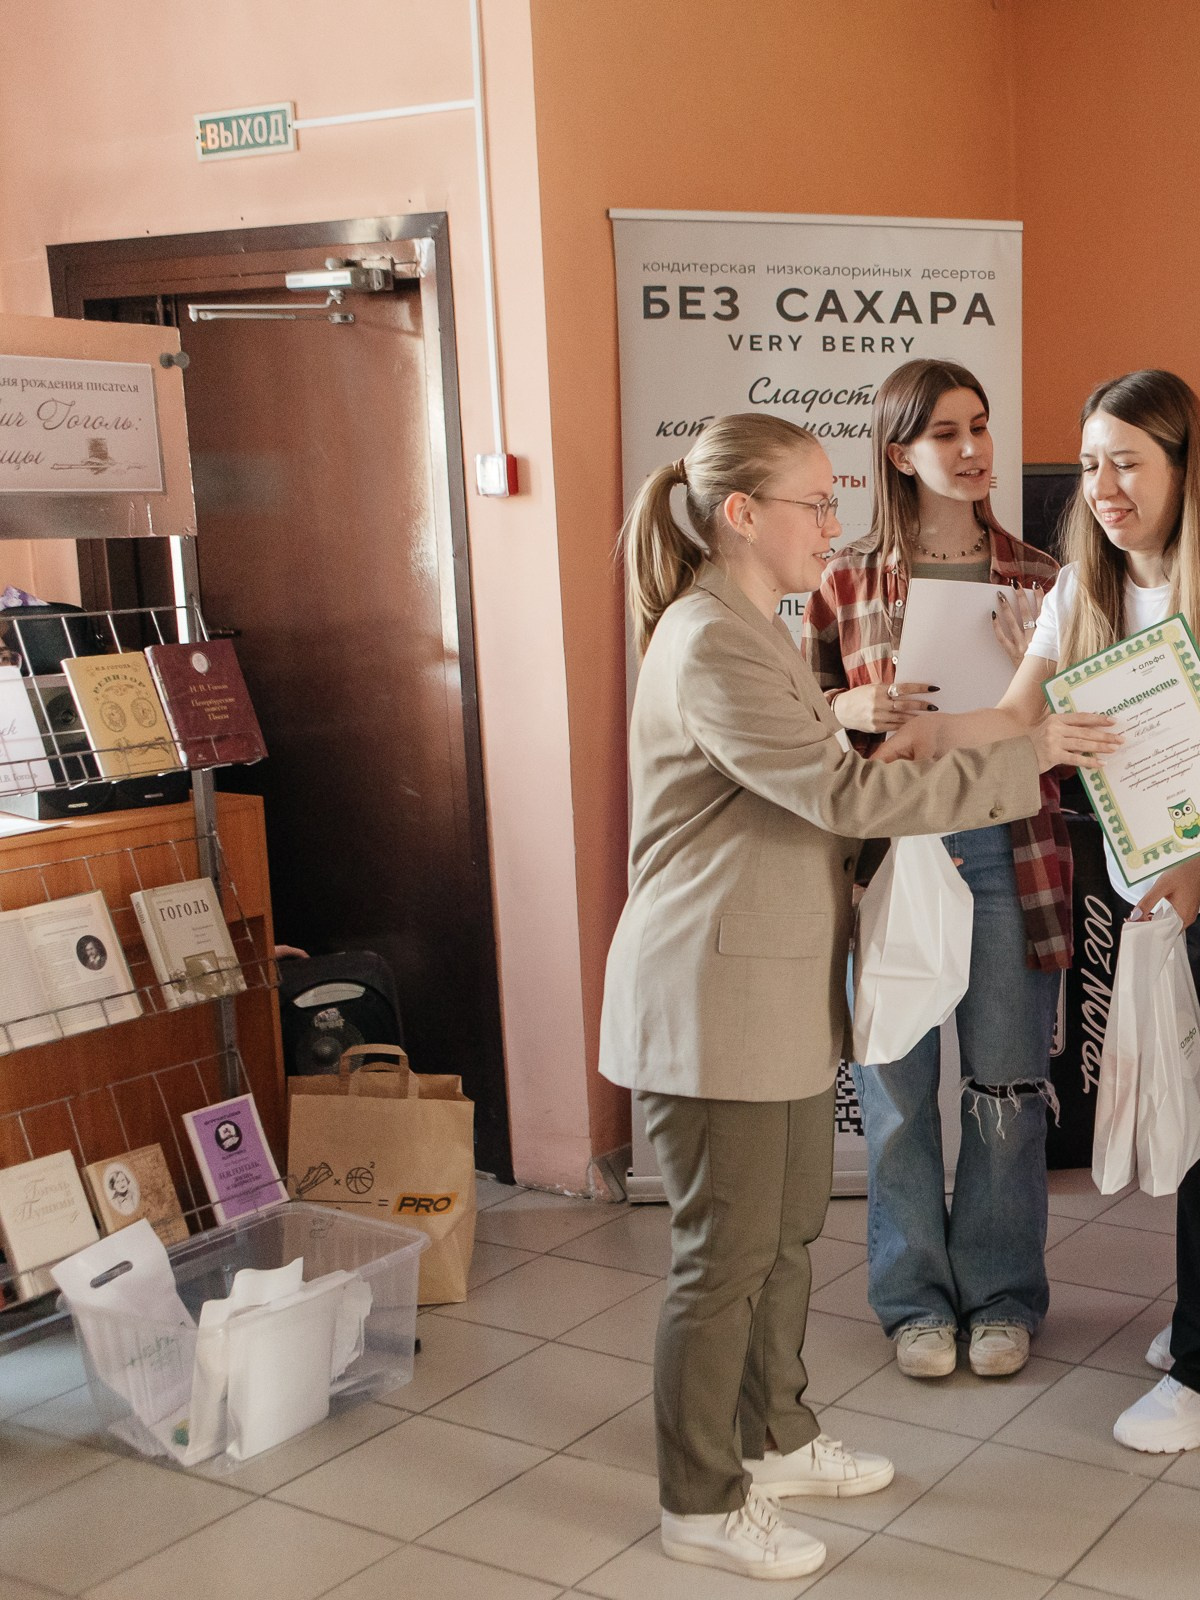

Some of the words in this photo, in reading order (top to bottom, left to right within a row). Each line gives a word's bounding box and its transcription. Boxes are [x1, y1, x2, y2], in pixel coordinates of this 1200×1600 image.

[205, 113, 286, 150] ВЫХОД
[642, 260, 756, 276] кондитерская
[766, 263, 912, 281] низкокалорийных
[921, 267, 996, 281] десертов
[642, 285, 740, 321] БЕЗ
[776, 287, 996, 326] САХАРА
[728, 334, 803, 352] VERY
[822, 335, 915, 353] BERRY
[21, 378, 84, 392] рождения
[86, 380, 140, 393] писателя
[159, 899, 210, 922] ГОГОЛЬ
[1084, 894, 1114, 975] 200
[398, 1196, 451, 1213] PRO
